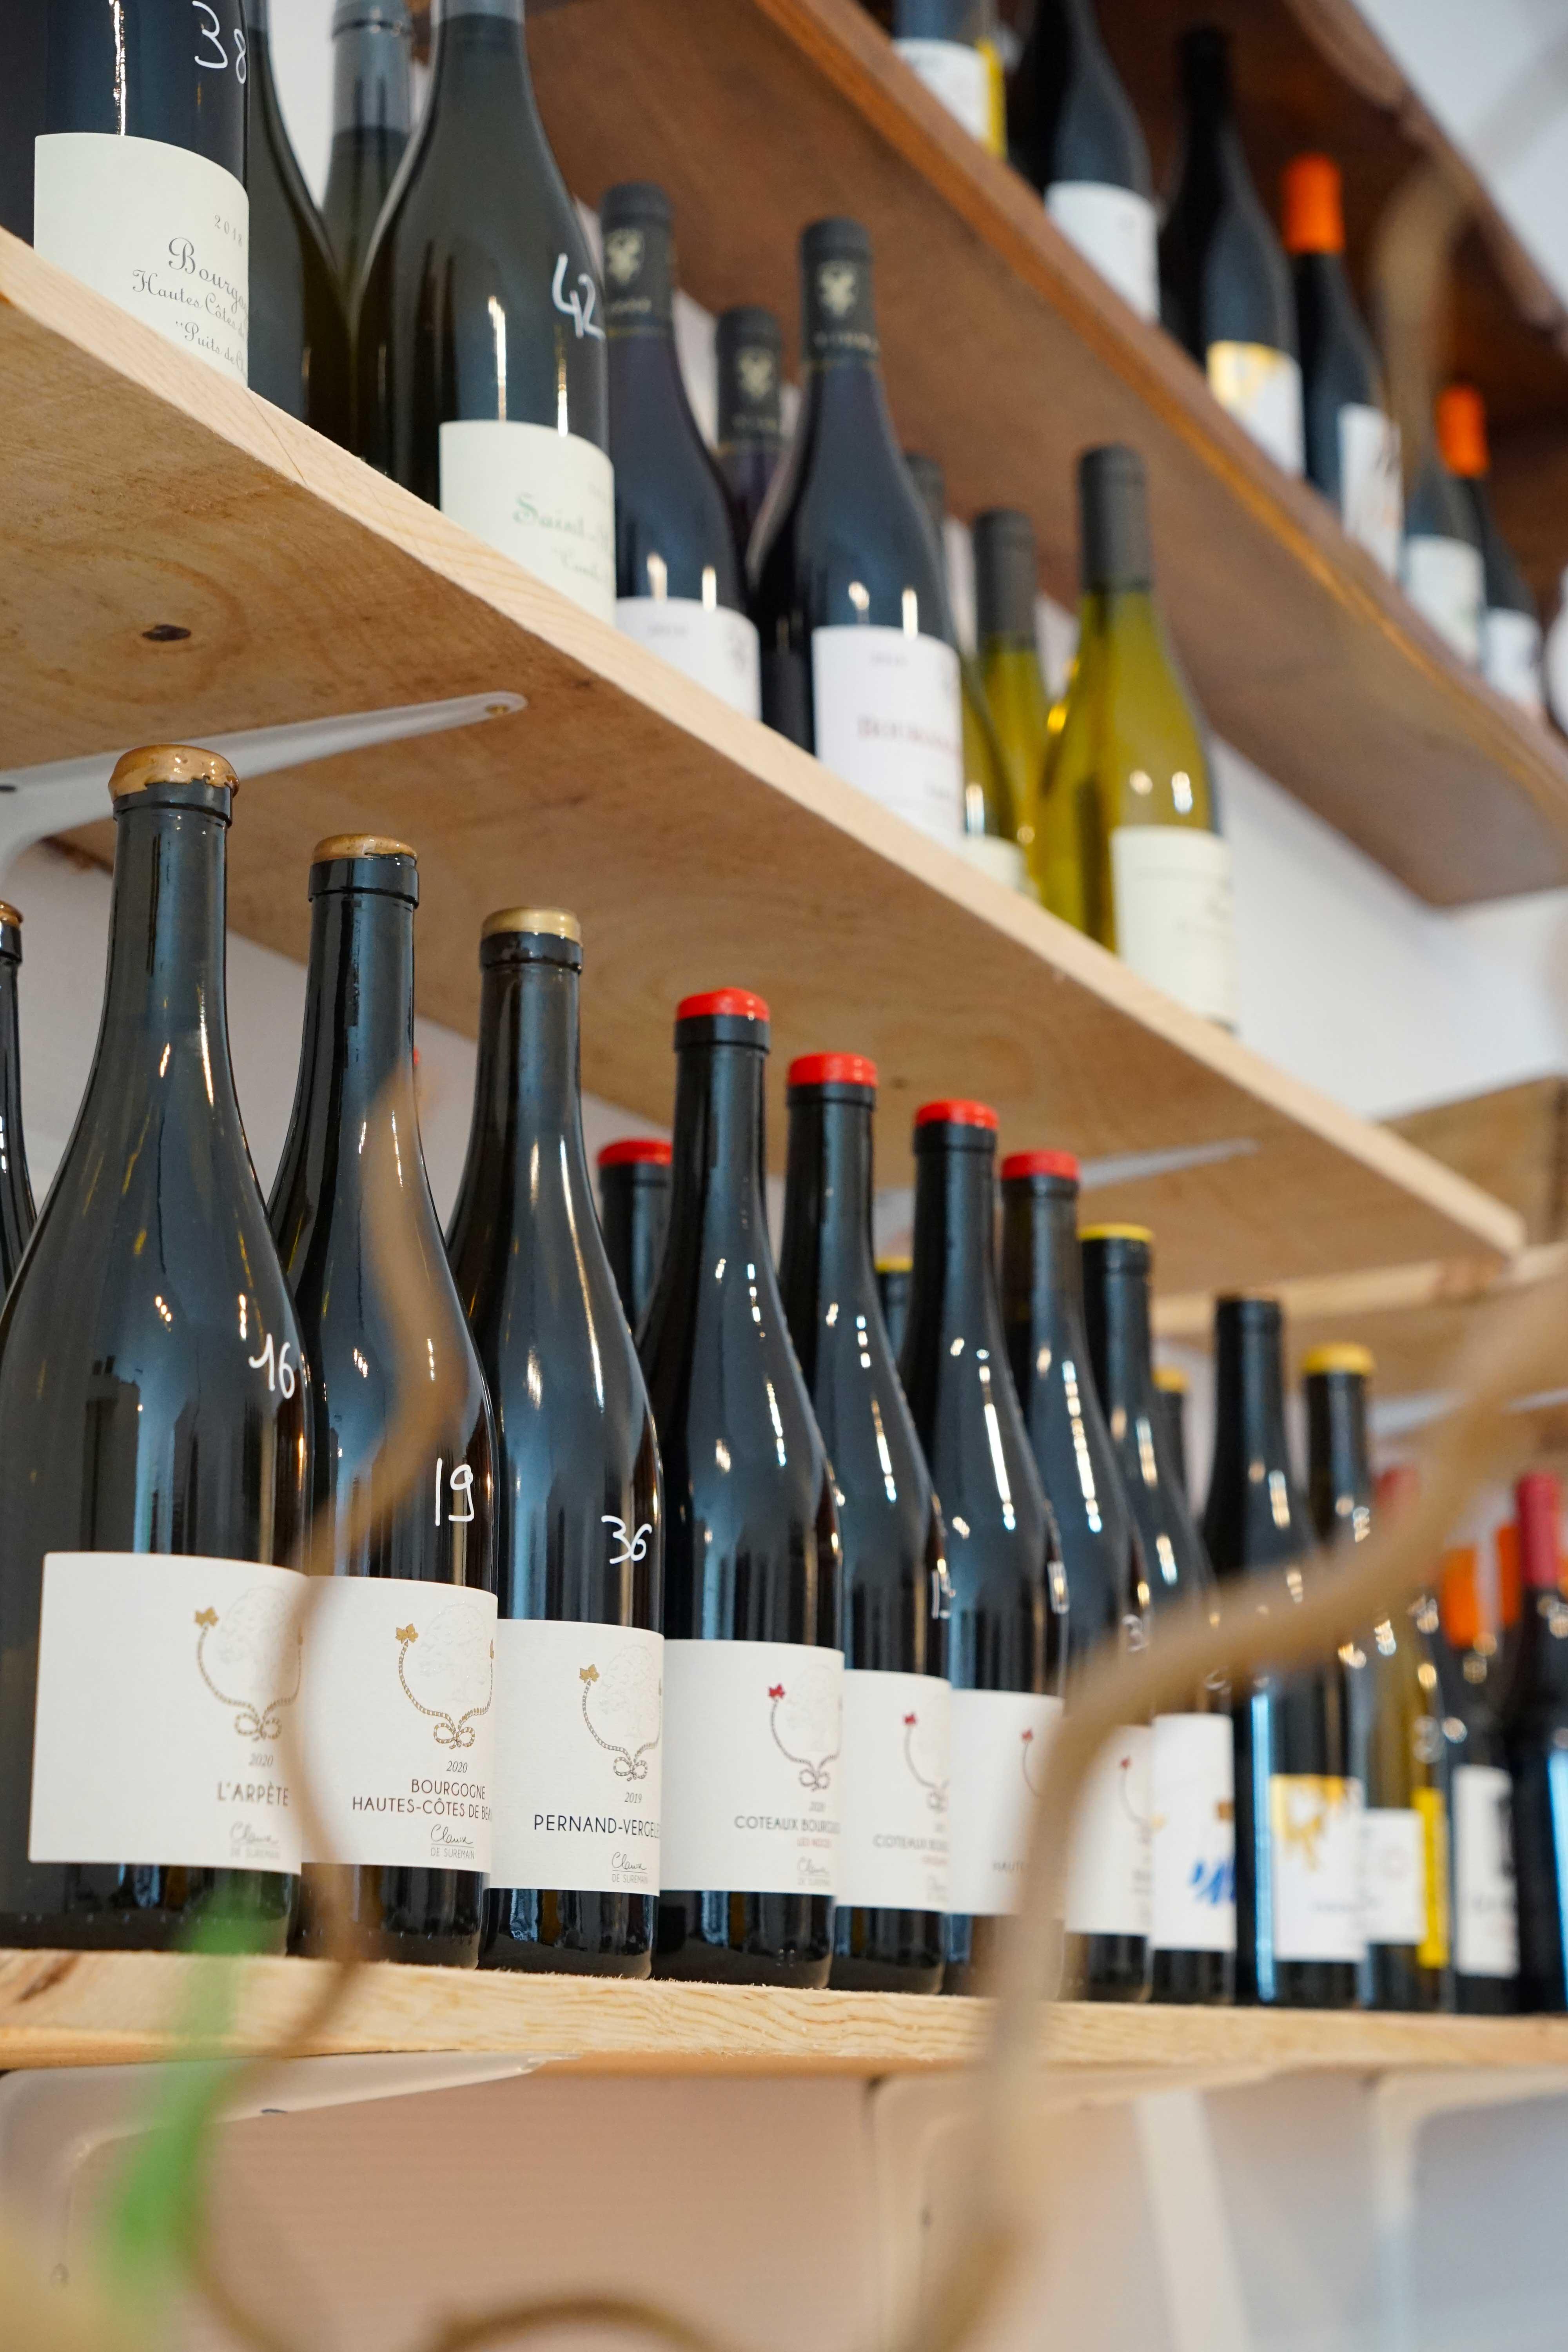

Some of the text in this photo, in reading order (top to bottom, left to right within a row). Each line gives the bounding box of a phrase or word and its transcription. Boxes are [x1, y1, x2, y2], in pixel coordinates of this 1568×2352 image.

[192, 0, 246, 84] 38
[132, 269, 203, 309] Hautes
[552, 252, 606, 339] 42
[249, 1334, 295, 1399] 16
[435, 1458, 474, 1526] 19
[601, 1515, 652, 1564] 36
[446, 1760, 468, 1773] 2020
[412, 1779, 485, 1800] BOURGOGNE
[624, 1792, 642, 1804] 2019
[352, 1796, 465, 1818] HAUTES-CÔTES
[468, 1804, 479, 1818] DE
[734, 1815, 799, 1831] COTEAUX
[430, 1847, 475, 1860] DE SUREMAIN
[612, 1874, 620, 1882] DE
